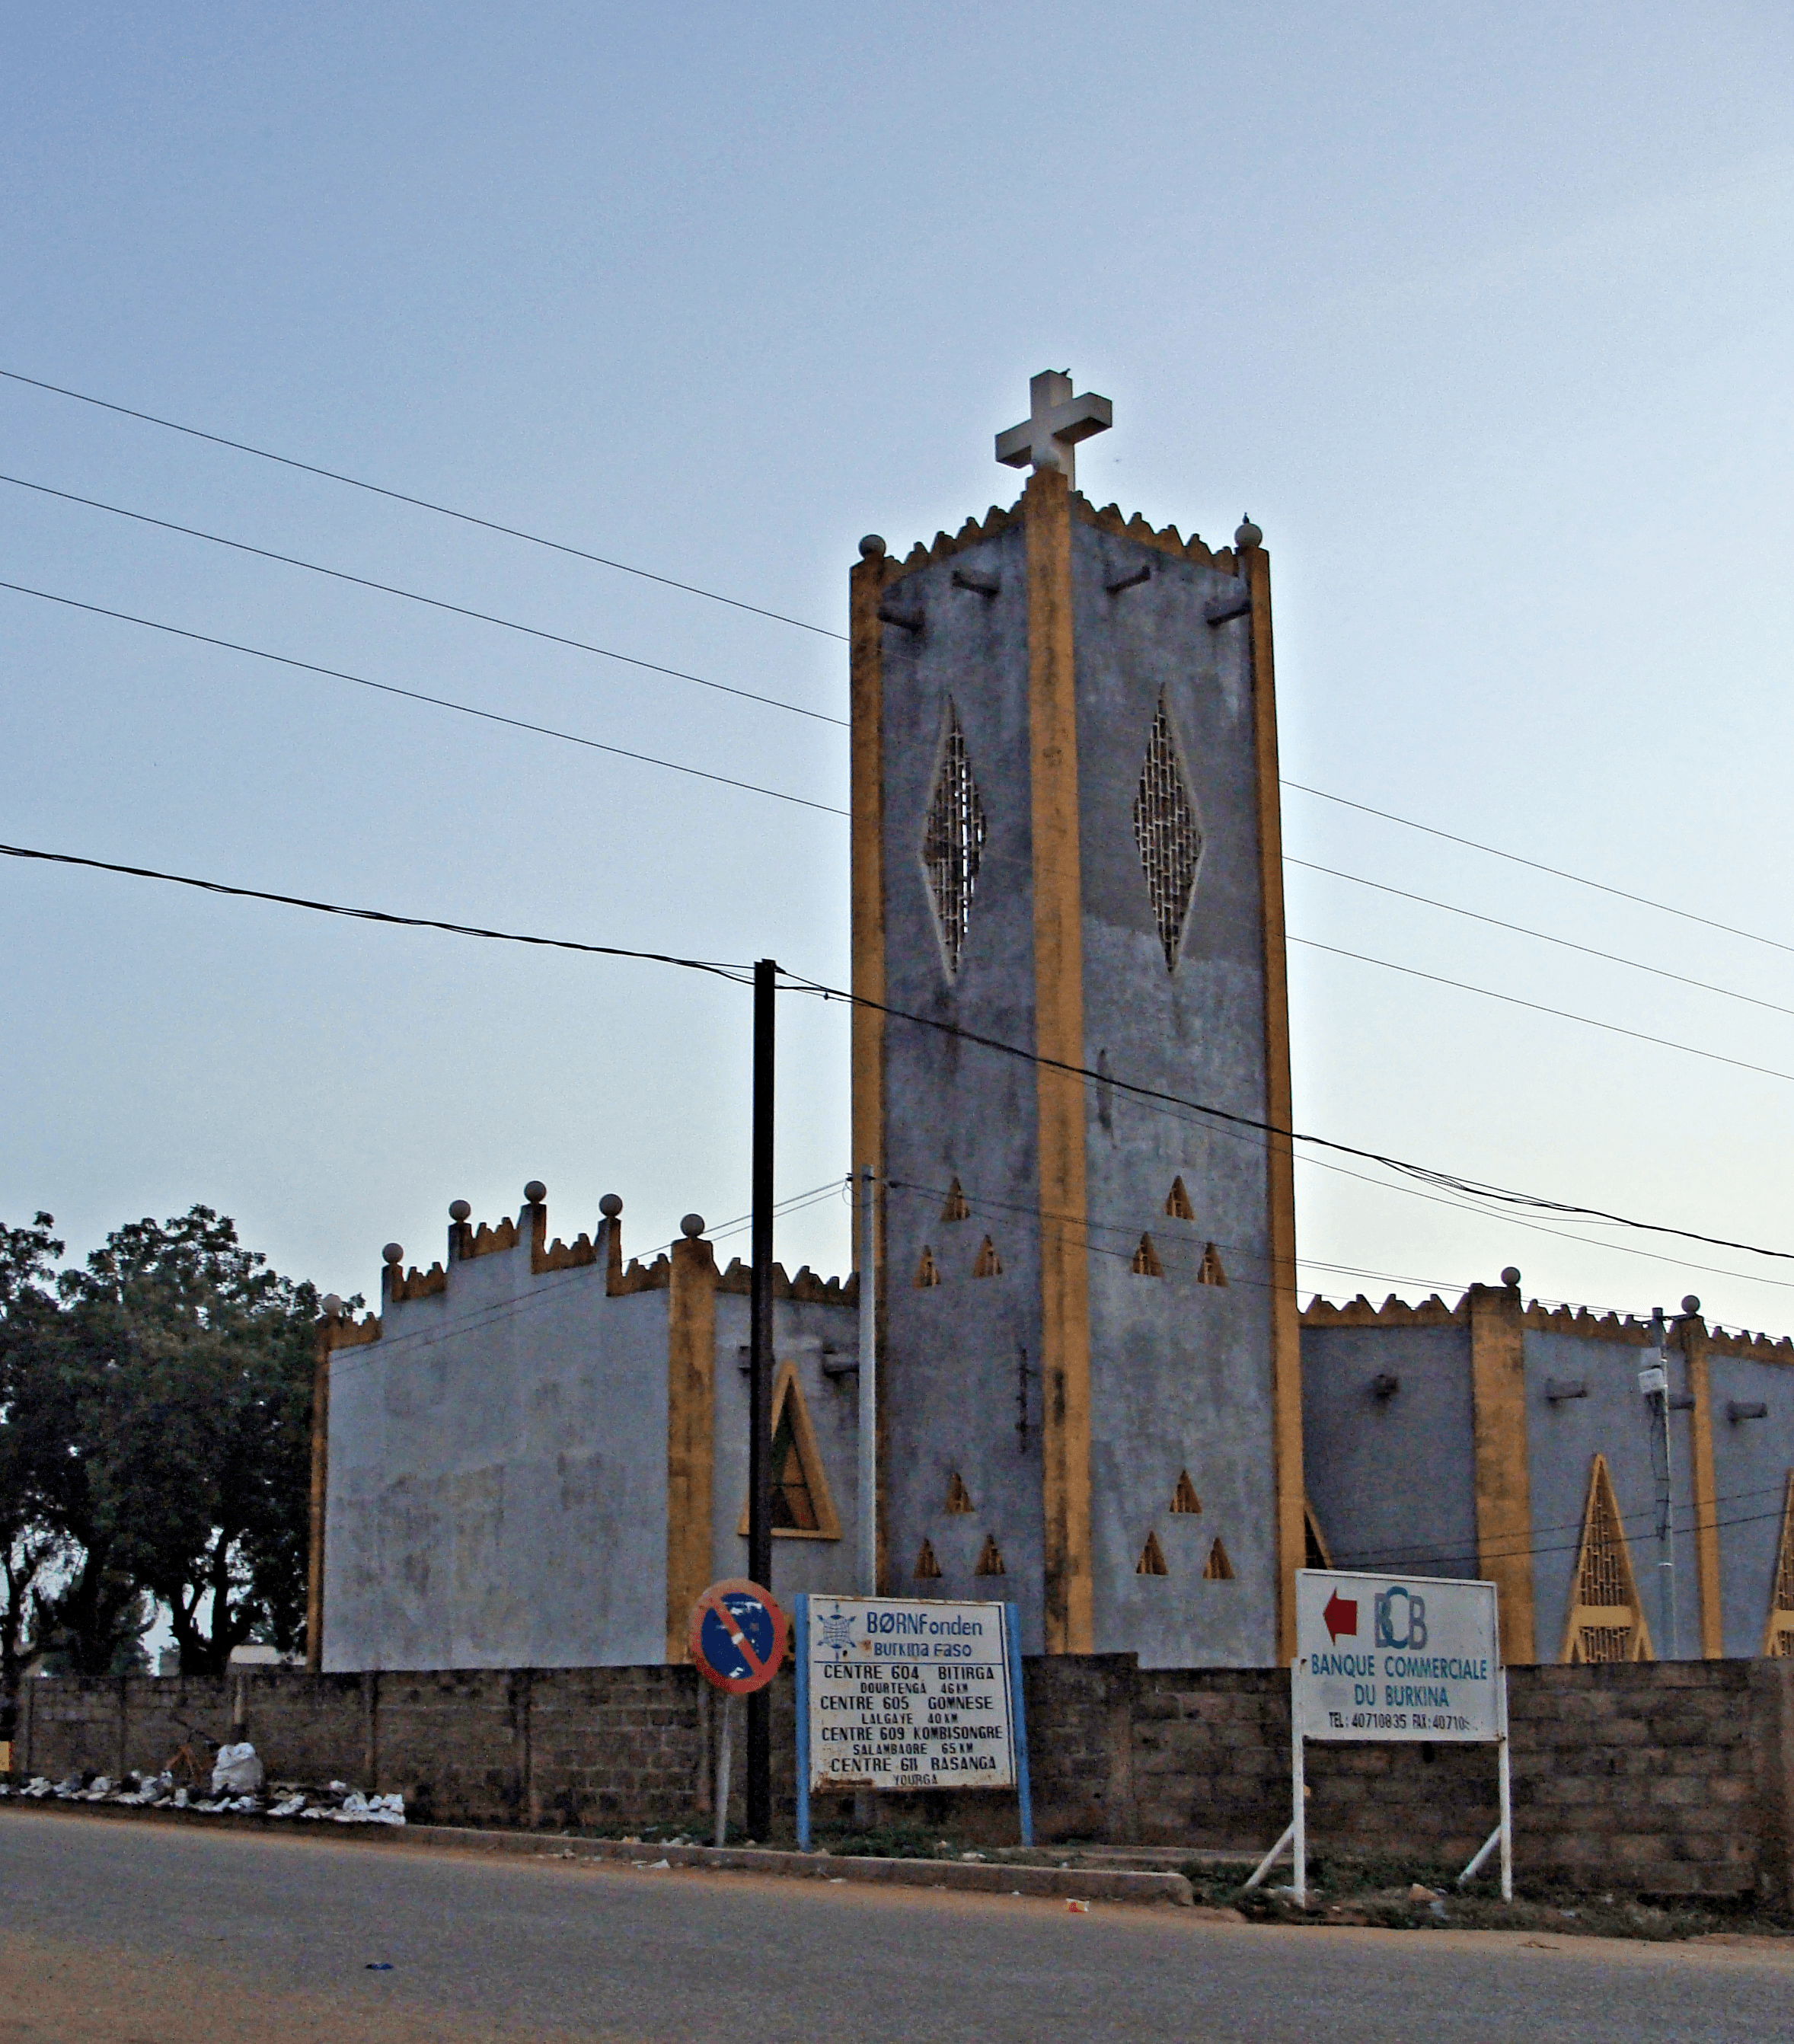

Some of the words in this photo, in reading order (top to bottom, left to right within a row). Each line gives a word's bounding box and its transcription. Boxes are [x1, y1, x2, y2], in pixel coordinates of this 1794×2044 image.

[934, 1643, 972, 1657] Faso
[824, 1665, 882, 1679] CENTRE
[891, 1666, 919, 1680] 604
[938, 1666, 994, 1680] BITIRGA
[1311, 1654, 1374, 1676] BANQUE
[1385, 1656, 1486, 1680] COMMERCIALE
[1355, 1684, 1375, 1705] DU
[1386, 1686, 1449, 1707] BURKINA
[821, 1697, 873, 1710] CENTRE
[883, 1697, 909, 1709] 605
[862, 1713, 913, 1724] LALGAYE
[822, 1727, 873, 1741] CENTRE
[880, 1729, 905, 1739] 609
[914, 1726, 1003, 1739] KOMBISONGRE
[832, 1758, 892, 1771] CENTRE
[900, 1758, 918, 1771] 611
[894, 1774, 938, 1785] YOURGA
